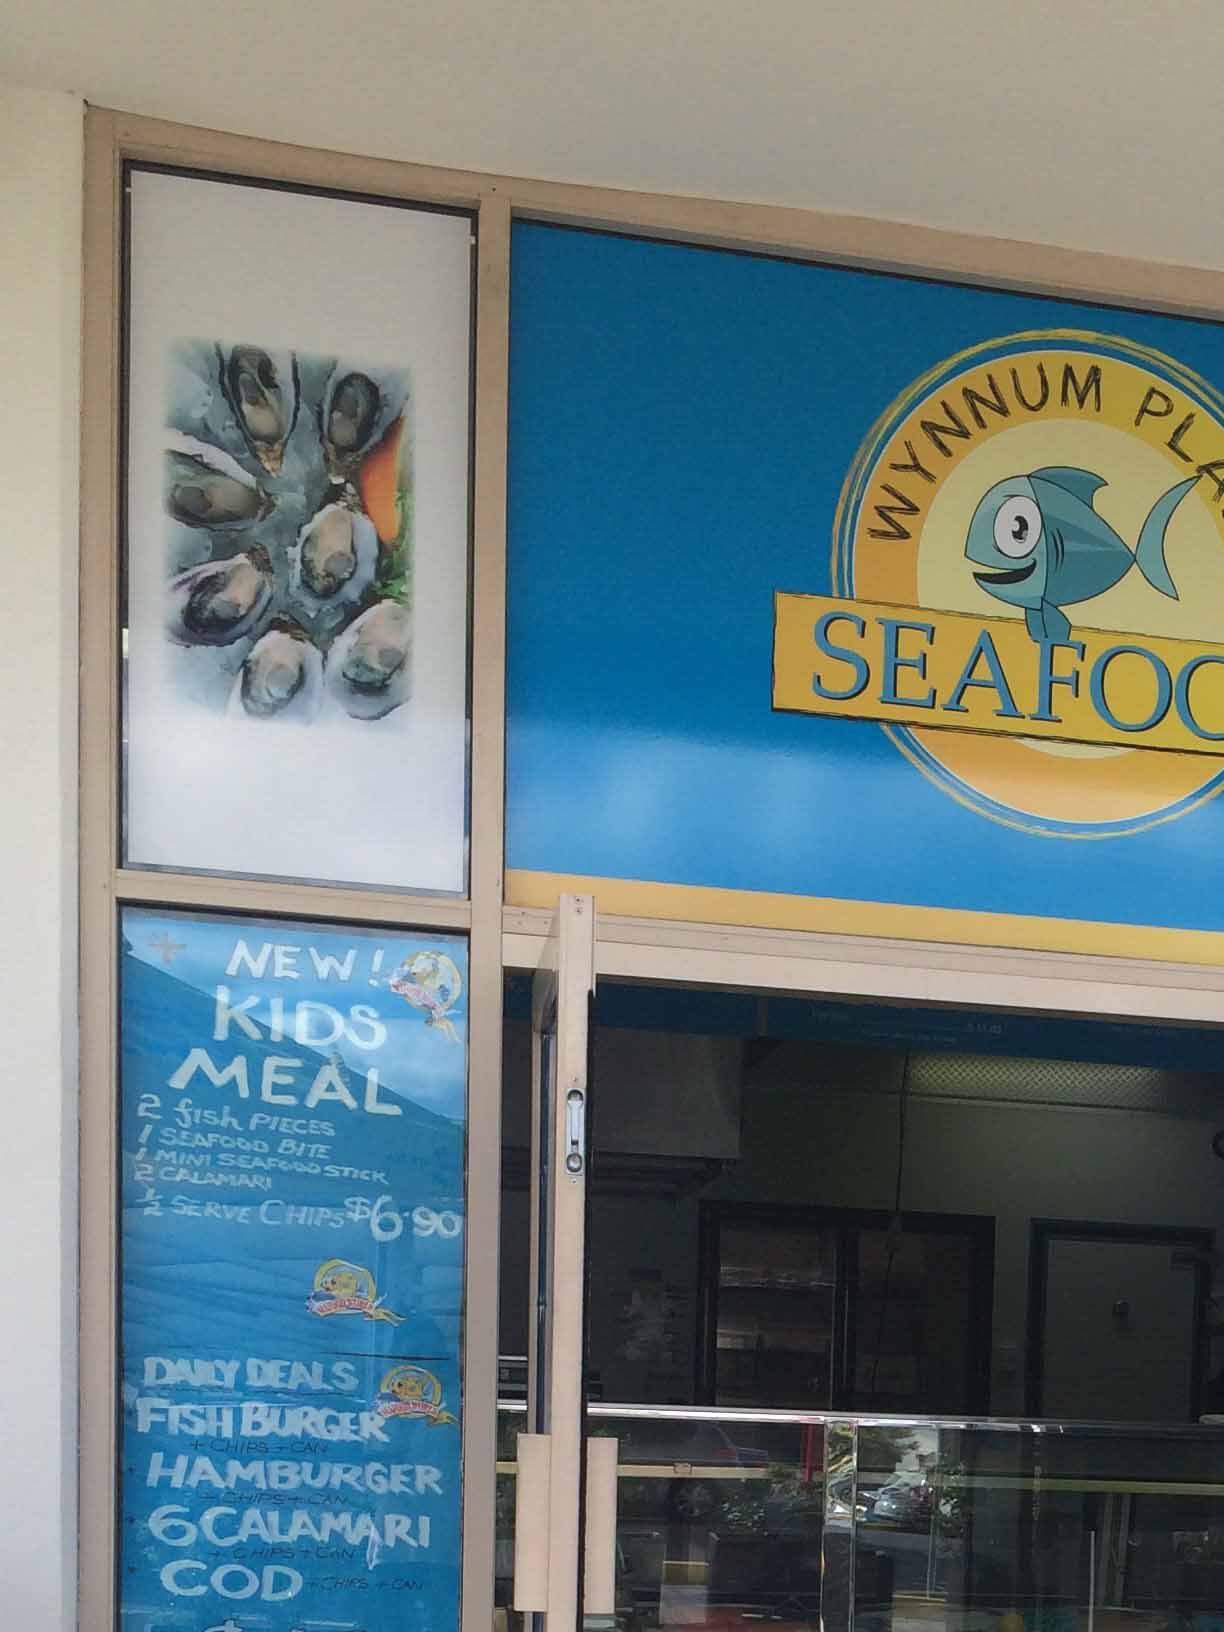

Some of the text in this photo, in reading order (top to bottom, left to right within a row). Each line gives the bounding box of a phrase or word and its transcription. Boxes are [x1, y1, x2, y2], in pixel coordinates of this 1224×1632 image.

[867, 362, 1102, 542] WYNNUM
[212, 984, 388, 1051] KIDS
[167, 1047, 403, 1117] MEAL
[137, 1093, 162, 1120] 2
[248, 1112, 336, 1137] PIECES
[158, 1127, 270, 1154] SEAFOOD
[276, 1137, 332, 1160] BITE
[154, 1149, 212, 1167] MINI
[322, 1163, 389, 1185] STICK
[158, 1166, 273, 1192] CALAMARI
[171, 1194, 250, 1224] SERVE
[258, 1199, 345, 1229] CHIPS
[143, 1356, 360, 1390] DAILY DEALS
[135, 1397, 233, 1438] FISH
[239, 1401, 391, 1443] BURGER
[209, 1439, 270, 1454] CHIPS
[145, 1451, 444, 1496] HAMBURGER
[159, 1559, 304, 1602] COD
